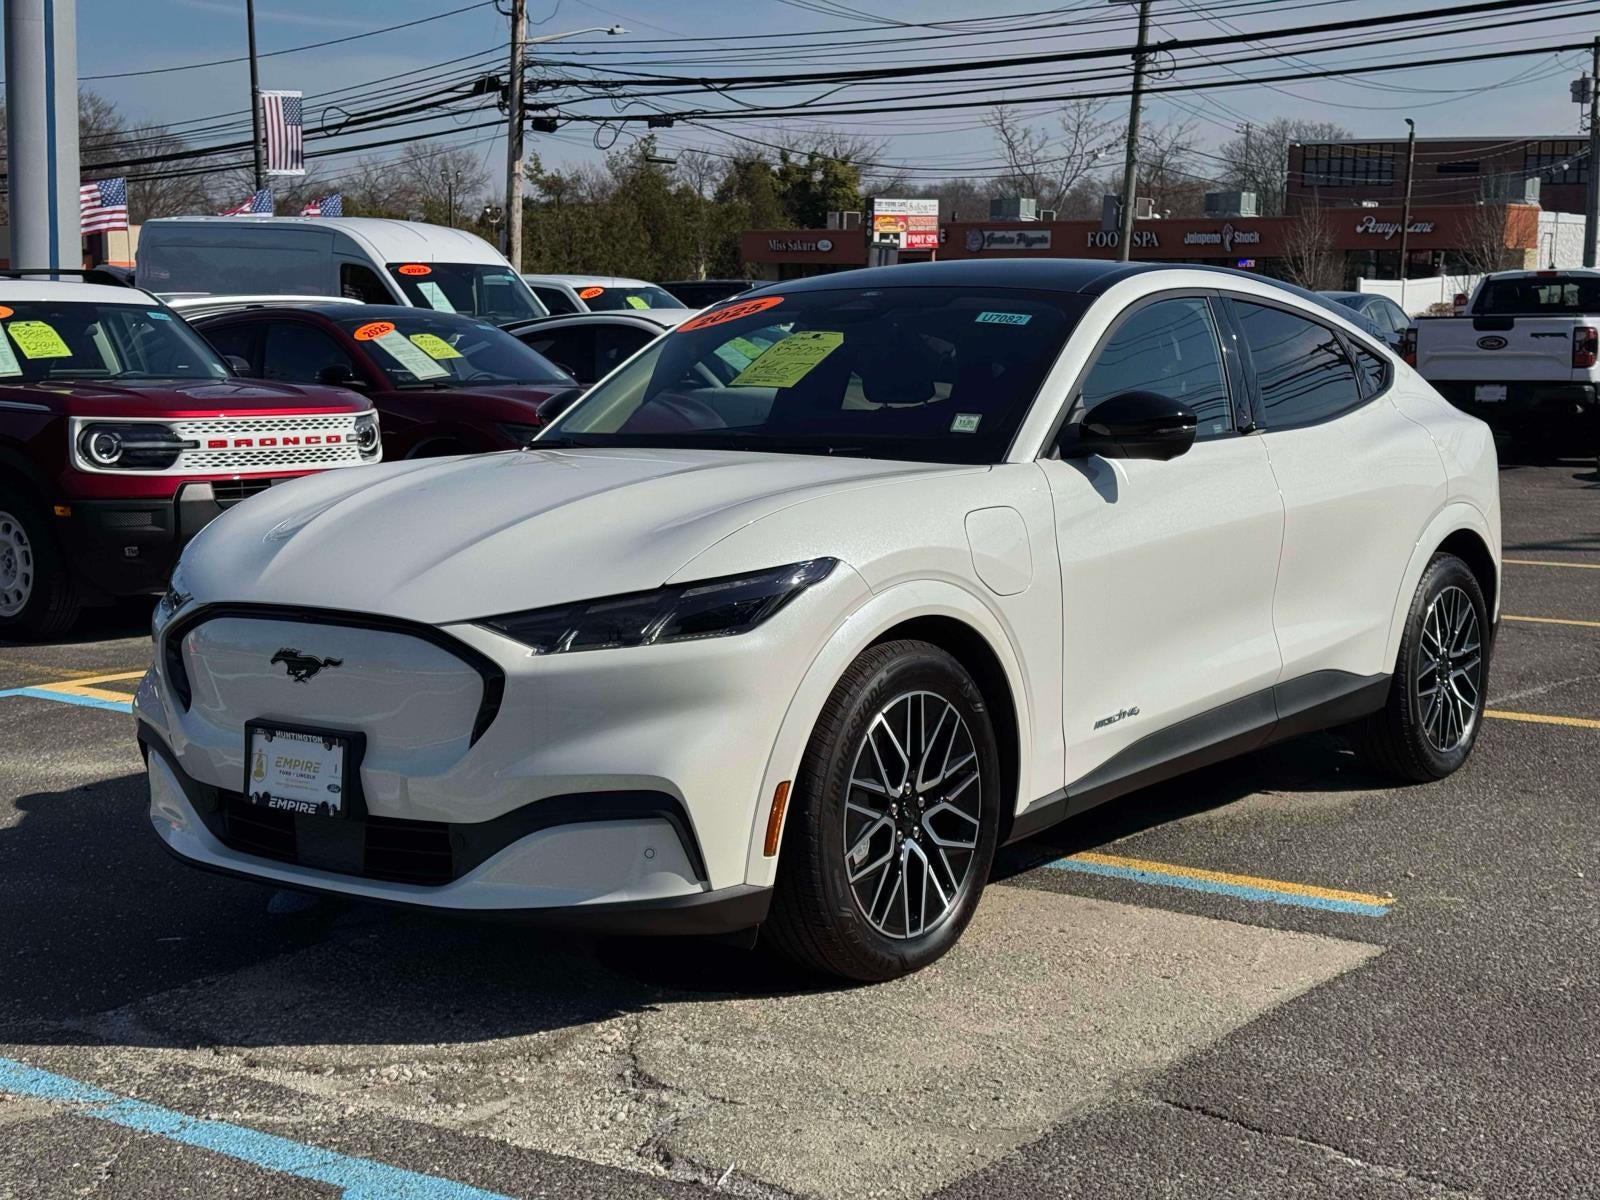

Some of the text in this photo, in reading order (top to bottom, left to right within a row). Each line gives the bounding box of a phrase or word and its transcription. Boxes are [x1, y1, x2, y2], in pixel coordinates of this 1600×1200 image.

[1355, 216, 1402, 240] Penny
[1087, 231, 1160, 248] FOO SPA
[1234, 231, 1260, 244] Shack
[768, 240, 787, 252] Miss
[787, 240, 817, 252] Sakura
[692, 300, 768, 329] 2025
[363, 324, 391, 338] 2025
[207, 434, 342, 449] BRONCO
[275, 730, 323, 744] HUNTINGTON
[274, 756, 322, 774] EMPIRE
[268, 797, 318, 815] EMPIRE
